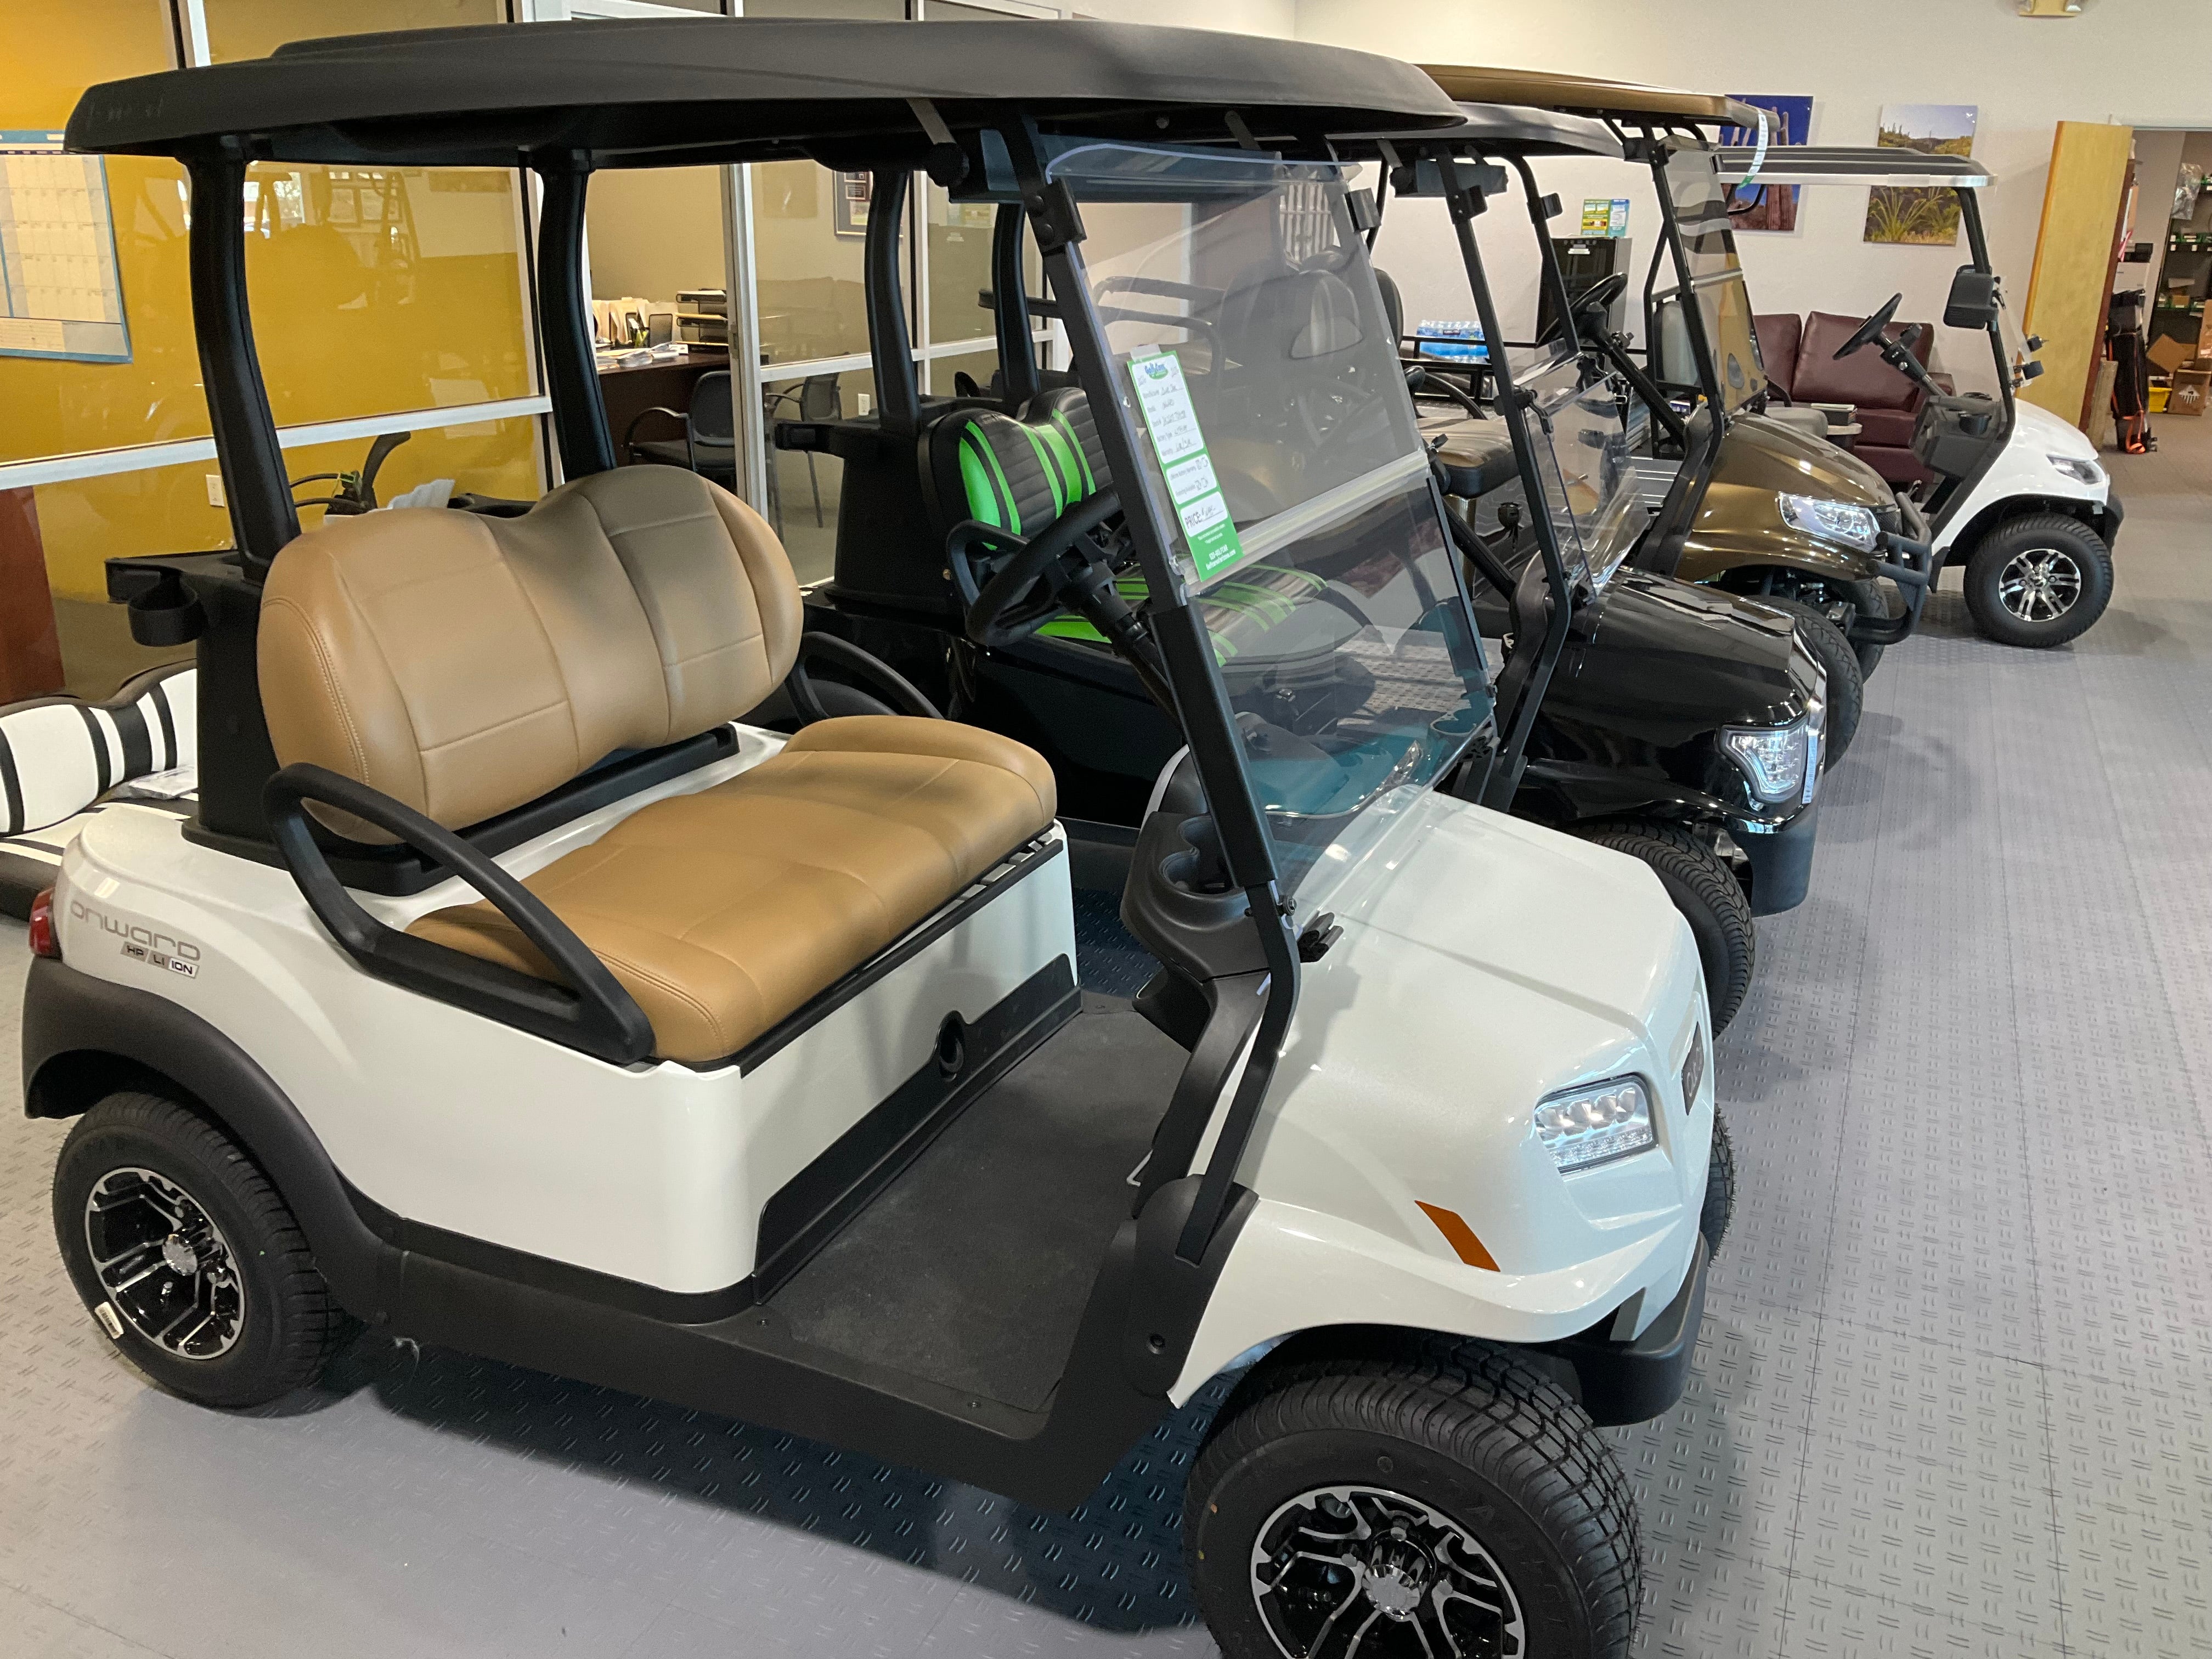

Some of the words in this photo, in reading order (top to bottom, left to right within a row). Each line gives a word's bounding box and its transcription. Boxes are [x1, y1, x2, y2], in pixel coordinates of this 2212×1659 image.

[1185, 512, 1201, 529] PRICE:
[126, 944, 144, 957] HP
[153, 953, 165, 966] LI
[171, 960, 193, 975] ION
